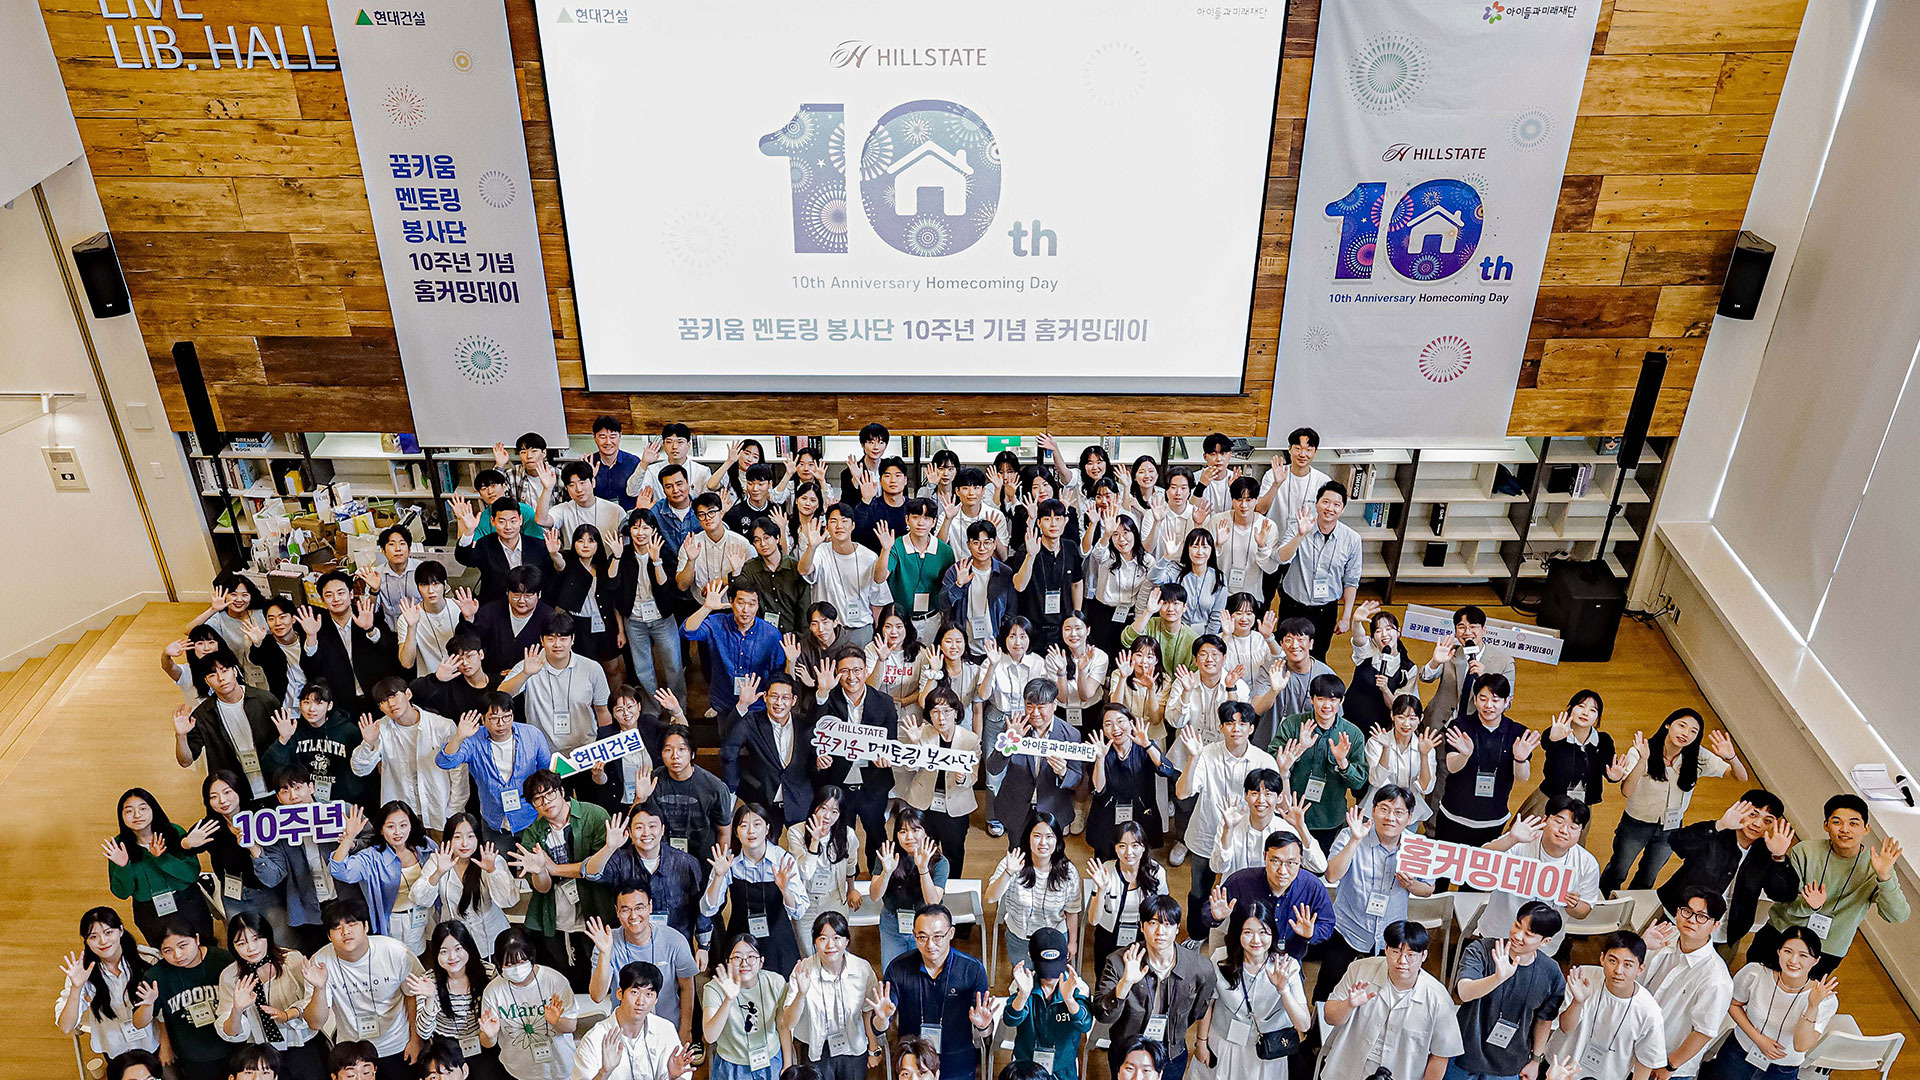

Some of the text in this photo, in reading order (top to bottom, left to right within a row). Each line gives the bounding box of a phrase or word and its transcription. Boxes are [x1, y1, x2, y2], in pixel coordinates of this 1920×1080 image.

[373, 10, 426, 26] 현대건설
[575, 8, 628, 24] 현대건설
[1196, 7, 1268, 20] 아이들과미래재단
[1506, 5, 1577, 20] 아이들과미래재단
[105, 24, 336, 71] LIB. HALL
[877, 48, 987, 66] HILLSTATE
[1413, 147, 1487, 161] HILLSTATE
[389, 154, 456, 180] 꿈키움
[395, 187, 462, 213] 멘토링
[402, 220, 467, 244] 봉사단
[408, 252, 515, 274] 10주년 기념
[413, 279, 520, 304] 홈커밍데이
[791, 275, 1058, 292] 10th Anniversary Homecoming Day
[1329, 292, 1510, 305] 10th Anniversary Homecoming Day
[678, 317, 1148, 342] 꿈키움 멘토링 봉사단 10주년 기념 홈커밍데이
[886, 664, 913, 676] Field
[837, 724, 884, 738] HILLSTATE
[573, 731, 642, 769] 현대건설
[813, 731, 977, 772] 꿈키움 멘토링 봉사단
[1021, 740, 1096, 760] 아이들과미래재단
[236, 803, 344, 844] 10주년
[1399, 837, 1574, 903] 홈커밍데이
[498, 998, 553, 1019] Mard
[1055, 1012, 1071, 1022] 031
